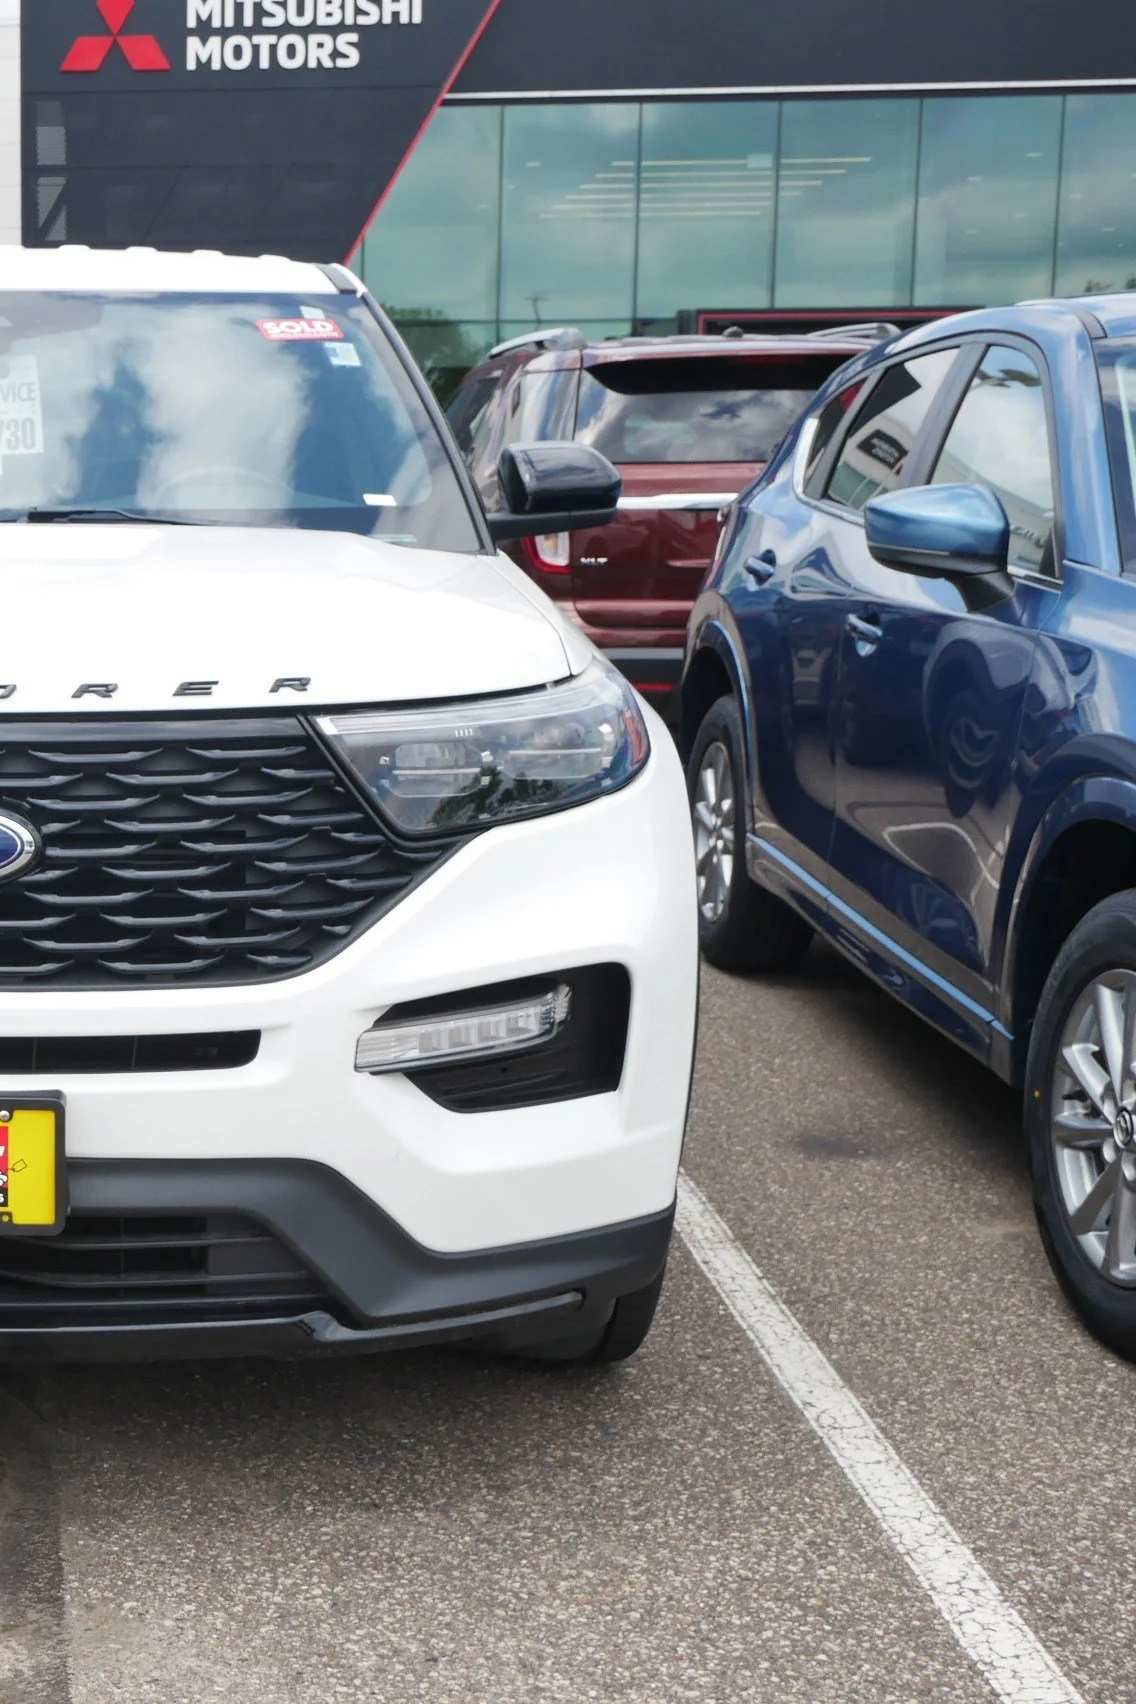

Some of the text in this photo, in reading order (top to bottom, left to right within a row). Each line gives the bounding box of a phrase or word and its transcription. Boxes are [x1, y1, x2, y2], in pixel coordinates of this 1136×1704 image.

[187, 0, 422, 28] MITSUBISHI
[186, 33, 360, 71] MOTORS
[263, 320, 334, 334] SOLD
